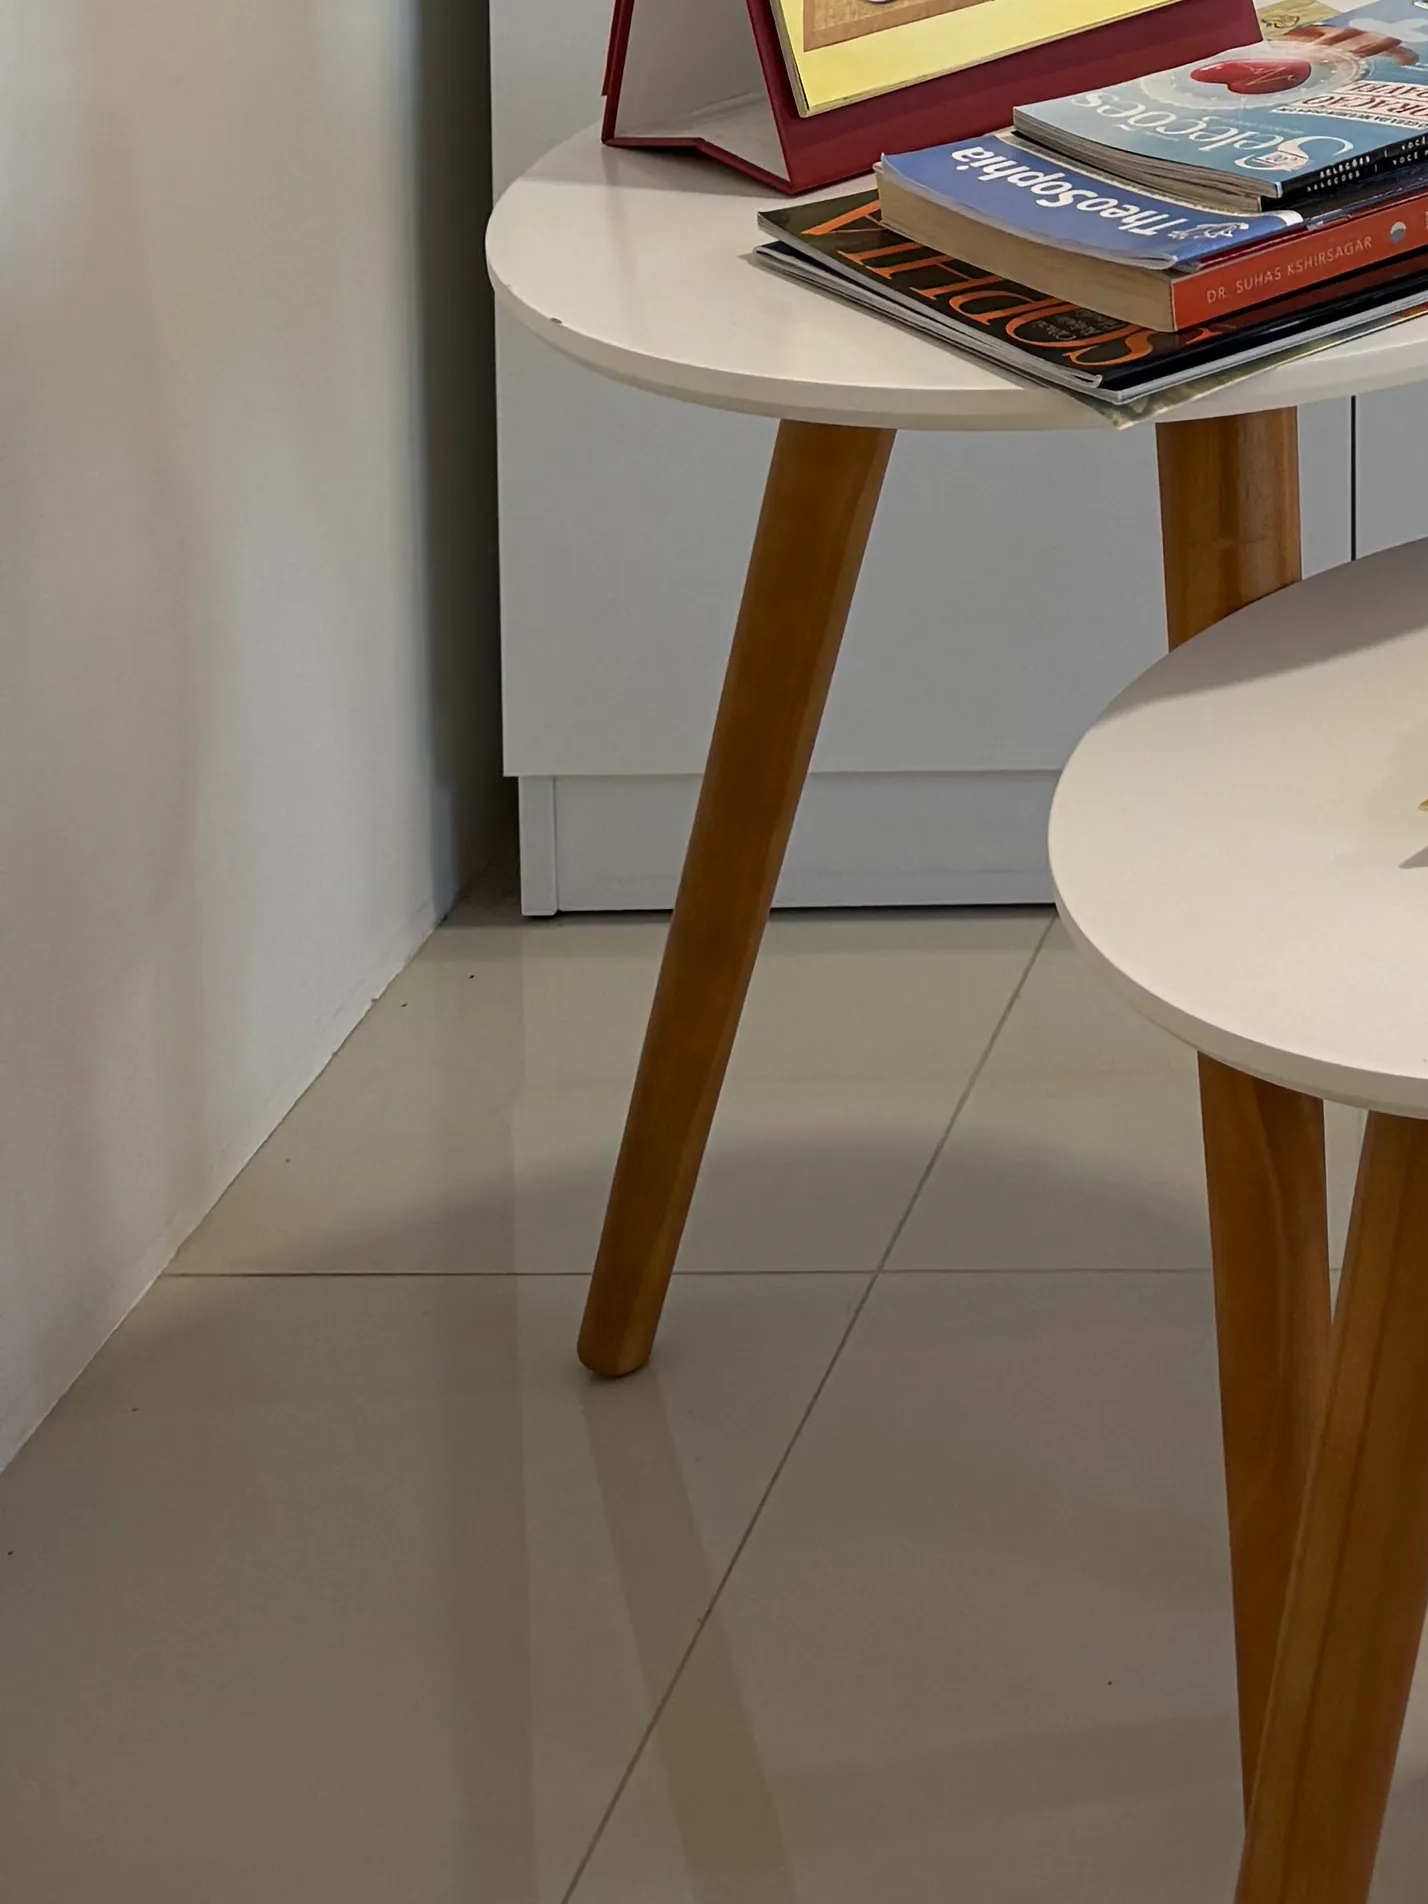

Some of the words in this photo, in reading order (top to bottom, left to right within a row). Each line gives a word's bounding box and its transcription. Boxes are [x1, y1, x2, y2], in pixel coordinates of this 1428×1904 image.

[1071, 91, 1354, 172] Seleções
[951, 145, 1189, 237] TheoSophia
[1236, 266, 1282, 294] SUHAS
[1287, 236, 1374, 277] KSHIRSAGAR
